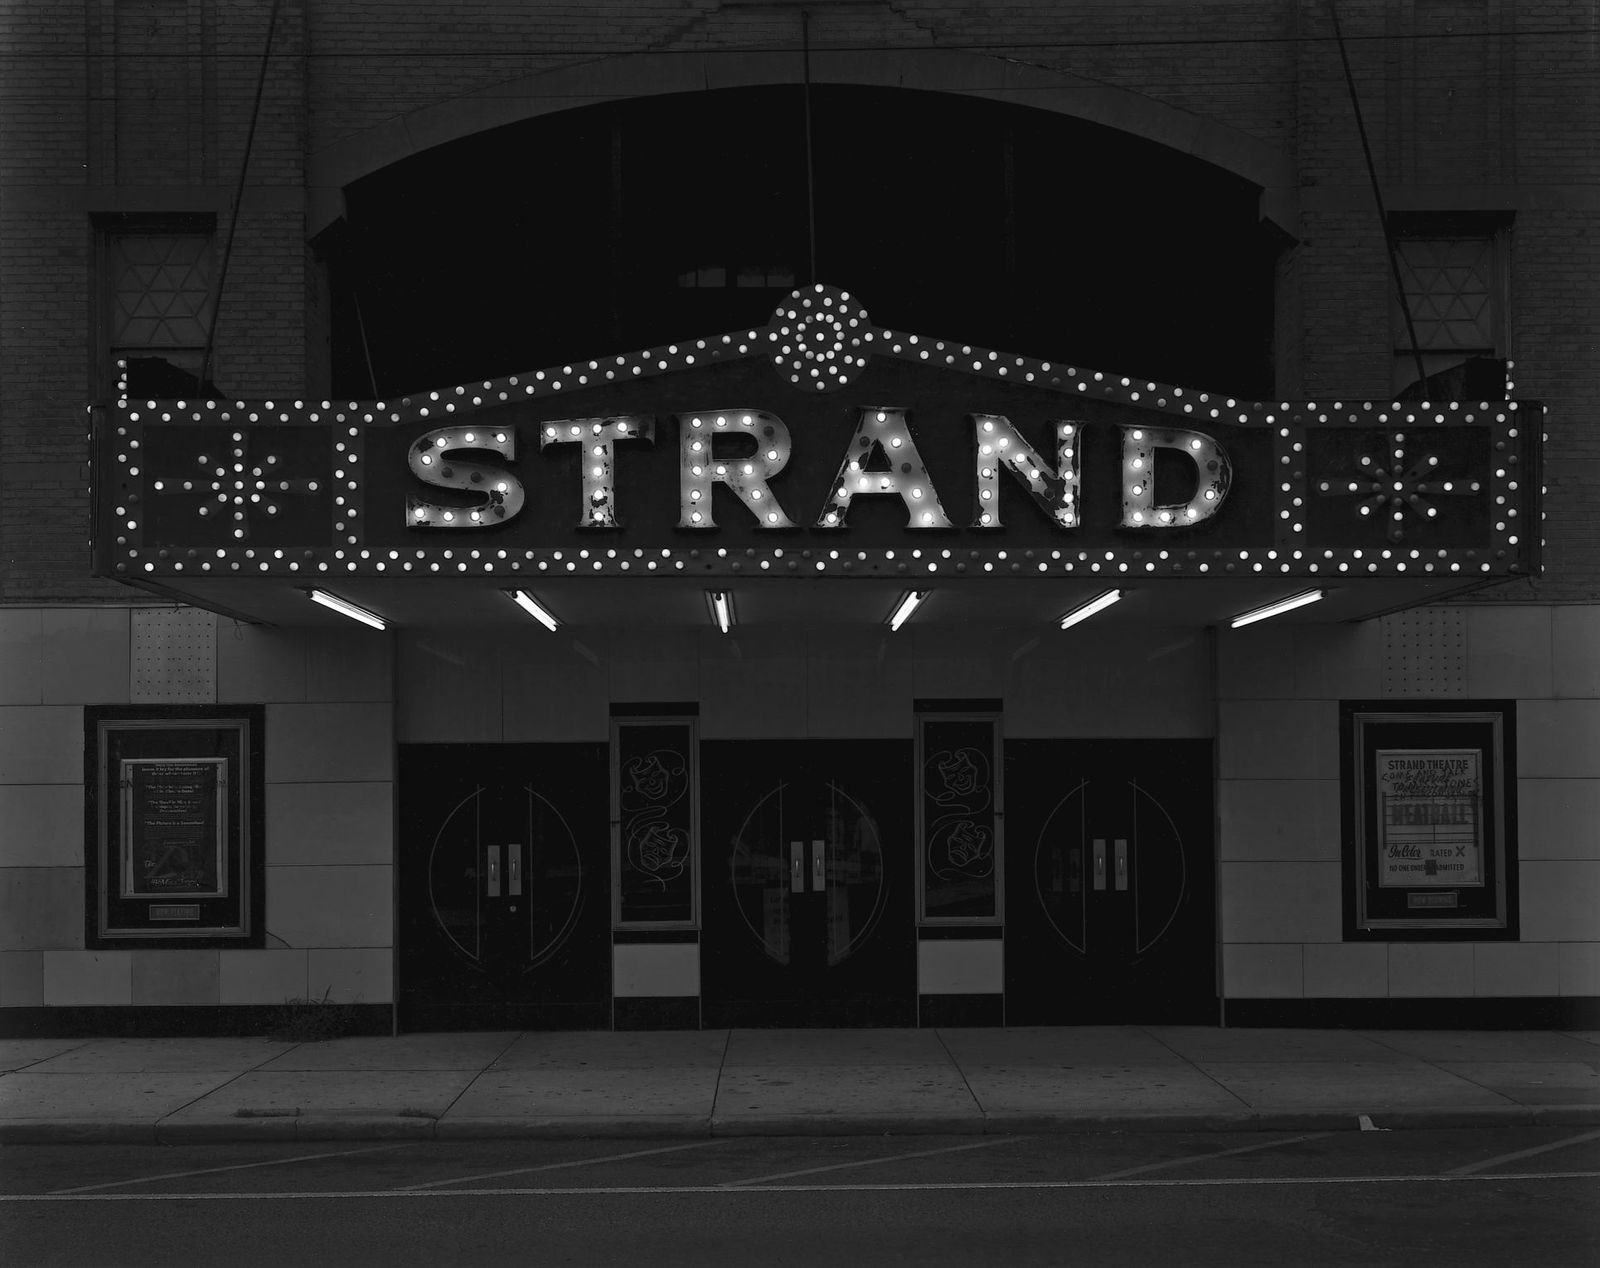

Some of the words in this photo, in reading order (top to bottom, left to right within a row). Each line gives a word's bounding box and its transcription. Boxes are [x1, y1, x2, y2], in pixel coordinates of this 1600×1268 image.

[405, 406, 1233, 532] STRAND
[1388, 759, 1425, 770] STRAND
[1427, 759, 1468, 770] THEATRE
[1430, 848, 1453, 857] RATED
[1456, 846, 1466, 857] X
[1389, 864, 1398, 872] NO
[1398, 864, 1410, 872] ONE
[1410, 864, 1426, 872] UNDE
